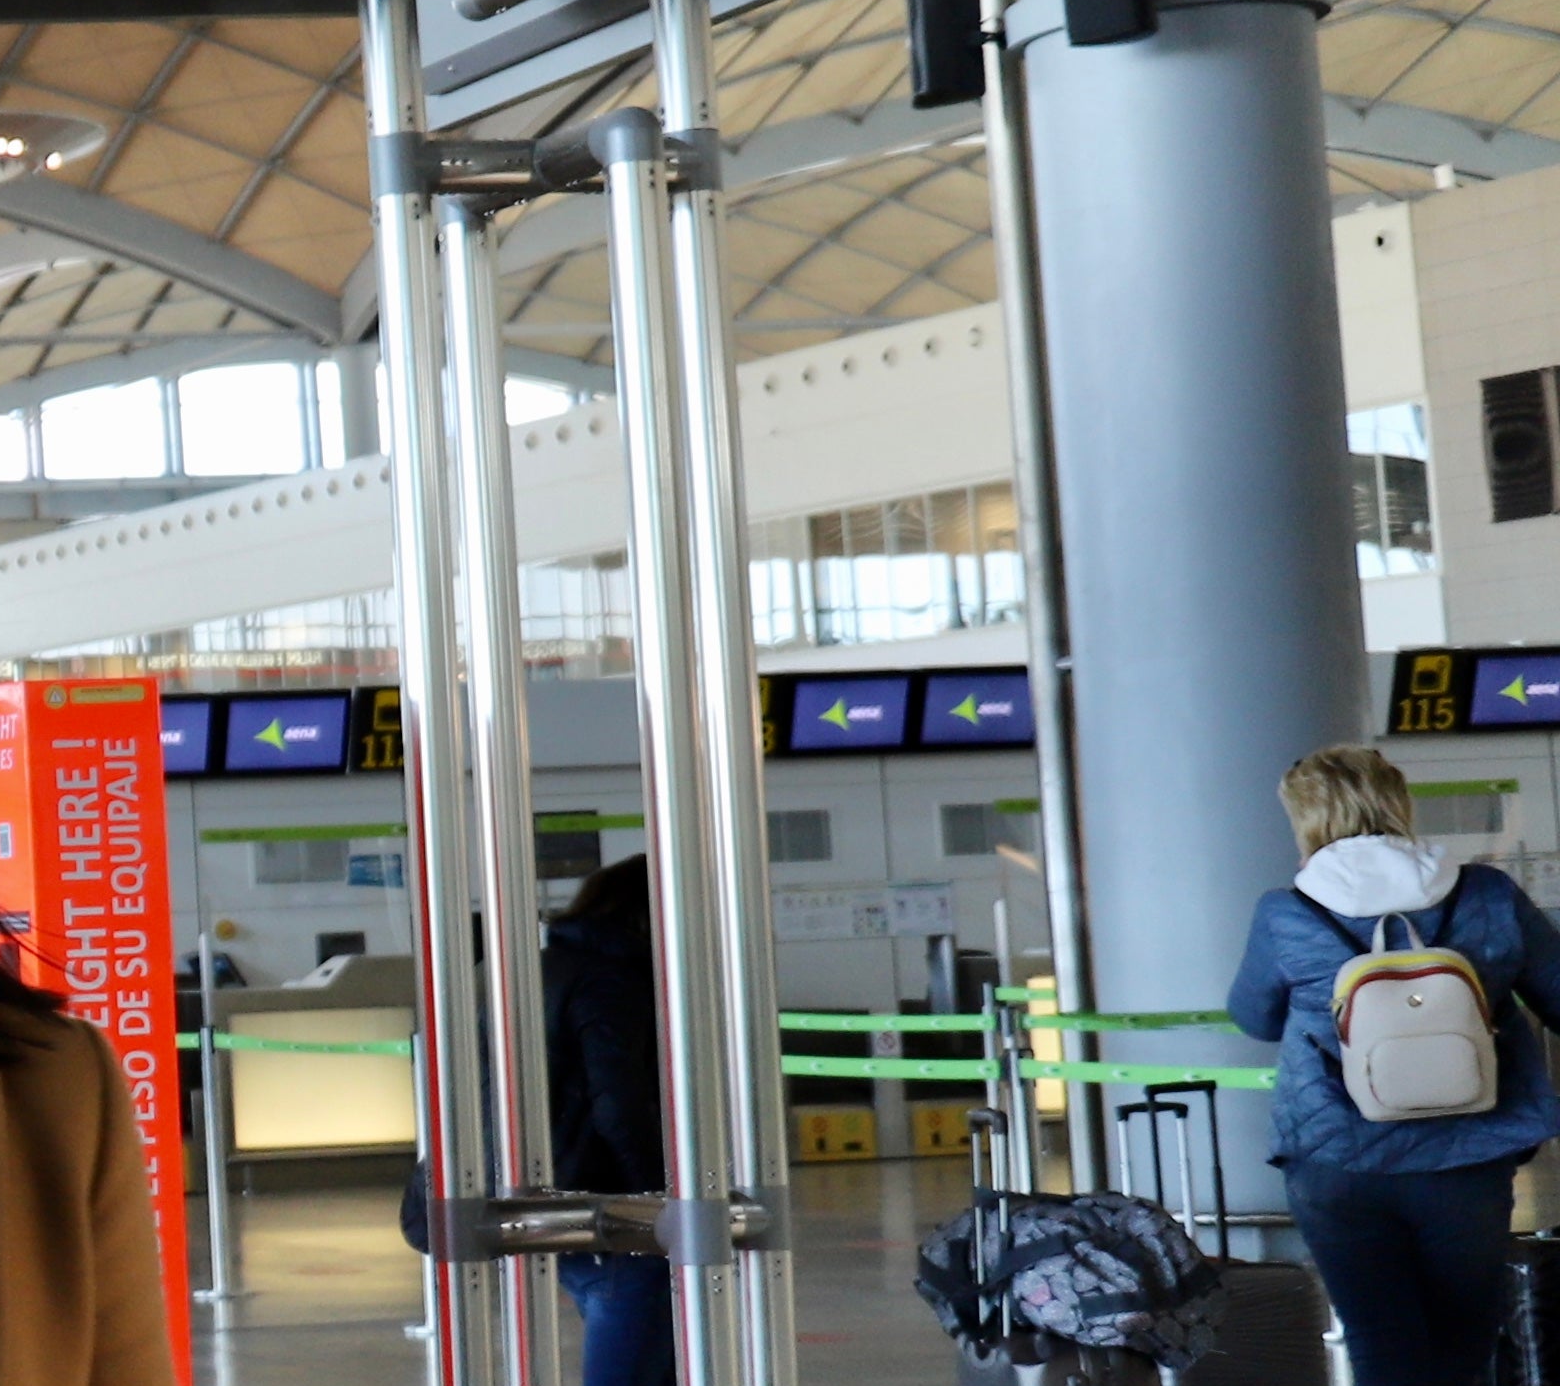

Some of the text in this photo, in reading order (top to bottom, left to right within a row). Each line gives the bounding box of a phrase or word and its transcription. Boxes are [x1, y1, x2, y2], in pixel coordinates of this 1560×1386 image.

[1397, 698, 1455, 732] 115
[361, 734, 404, 768] 11
[56, 767, 103, 881] HERE
[103, 738, 147, 915] EQUIPAJE
[113, 930, 148, 977] SU
[118, 990, 151, 1036] DE
